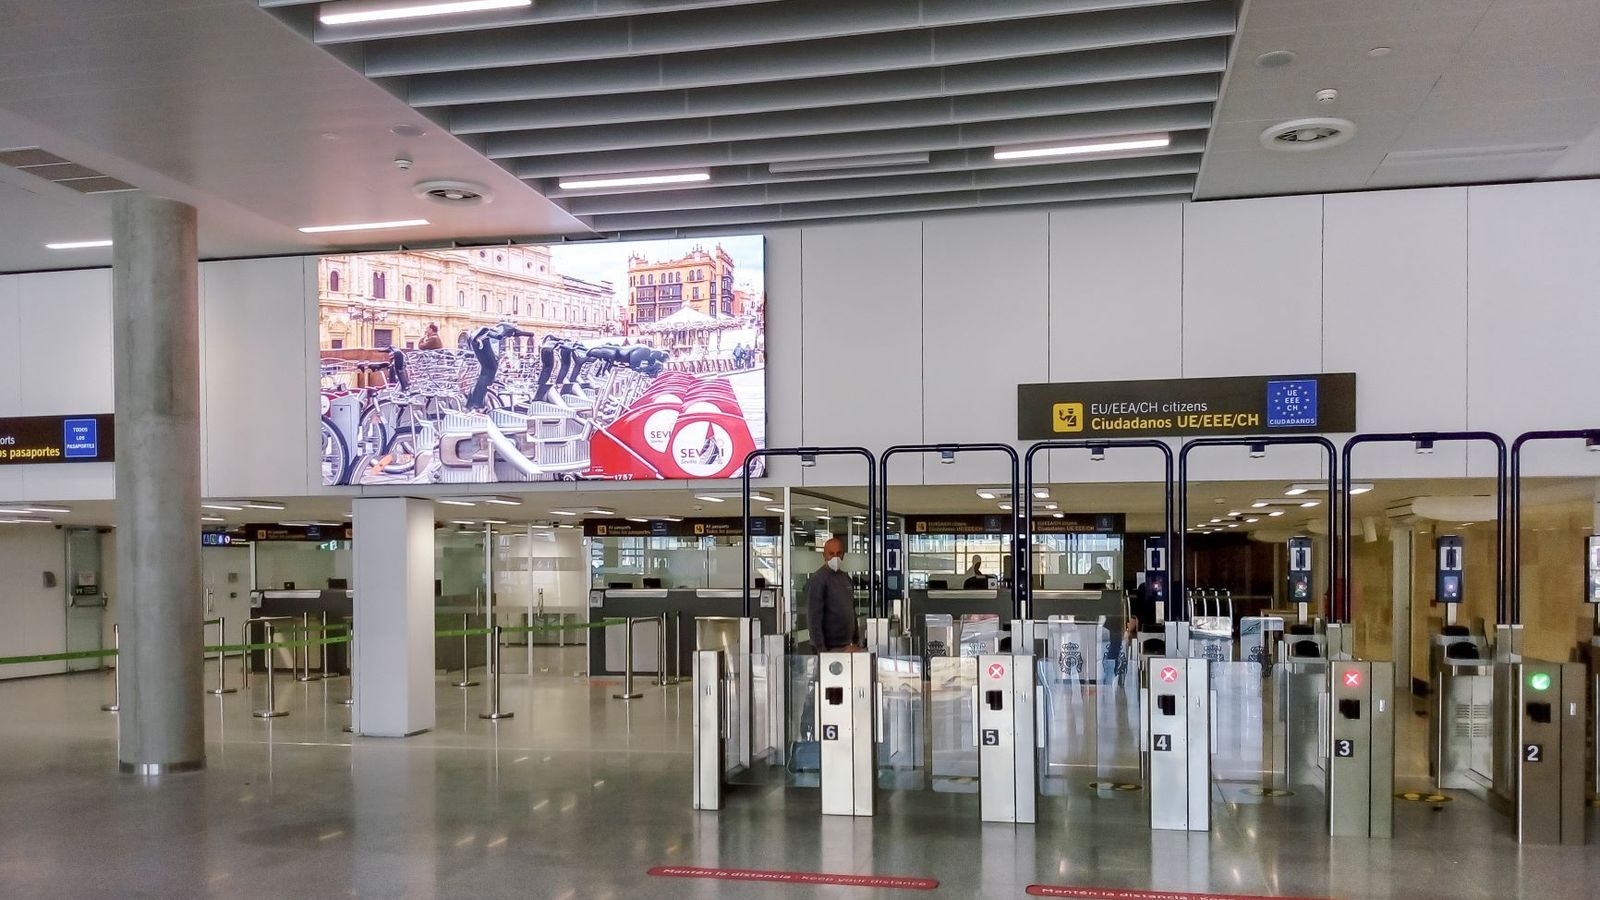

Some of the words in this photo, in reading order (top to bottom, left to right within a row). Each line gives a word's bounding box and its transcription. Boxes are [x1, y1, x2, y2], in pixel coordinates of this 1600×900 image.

[1091, 402, 1158, 415] EU/EEA/CH
[1162, 401, 1208, 412] citizens
[1091, 417, 1172, 430] Ciudadanos
[1177, 413, 1260, 428] UE/EEE/CH
[9, 446, 60, 460] pasaportes
[826, 725, 836, 740] 6
[986, 730, 997, 745] 5
[1156, 735, 1168, 750] 4
[1339, 740, 1351, 756] 3
[1526, 745, 1540, 761] 2
[730, 871, 791, 879] distancia
[870, 879, 927, 887] distance
[1119, 892, 1188, 900] distancia
